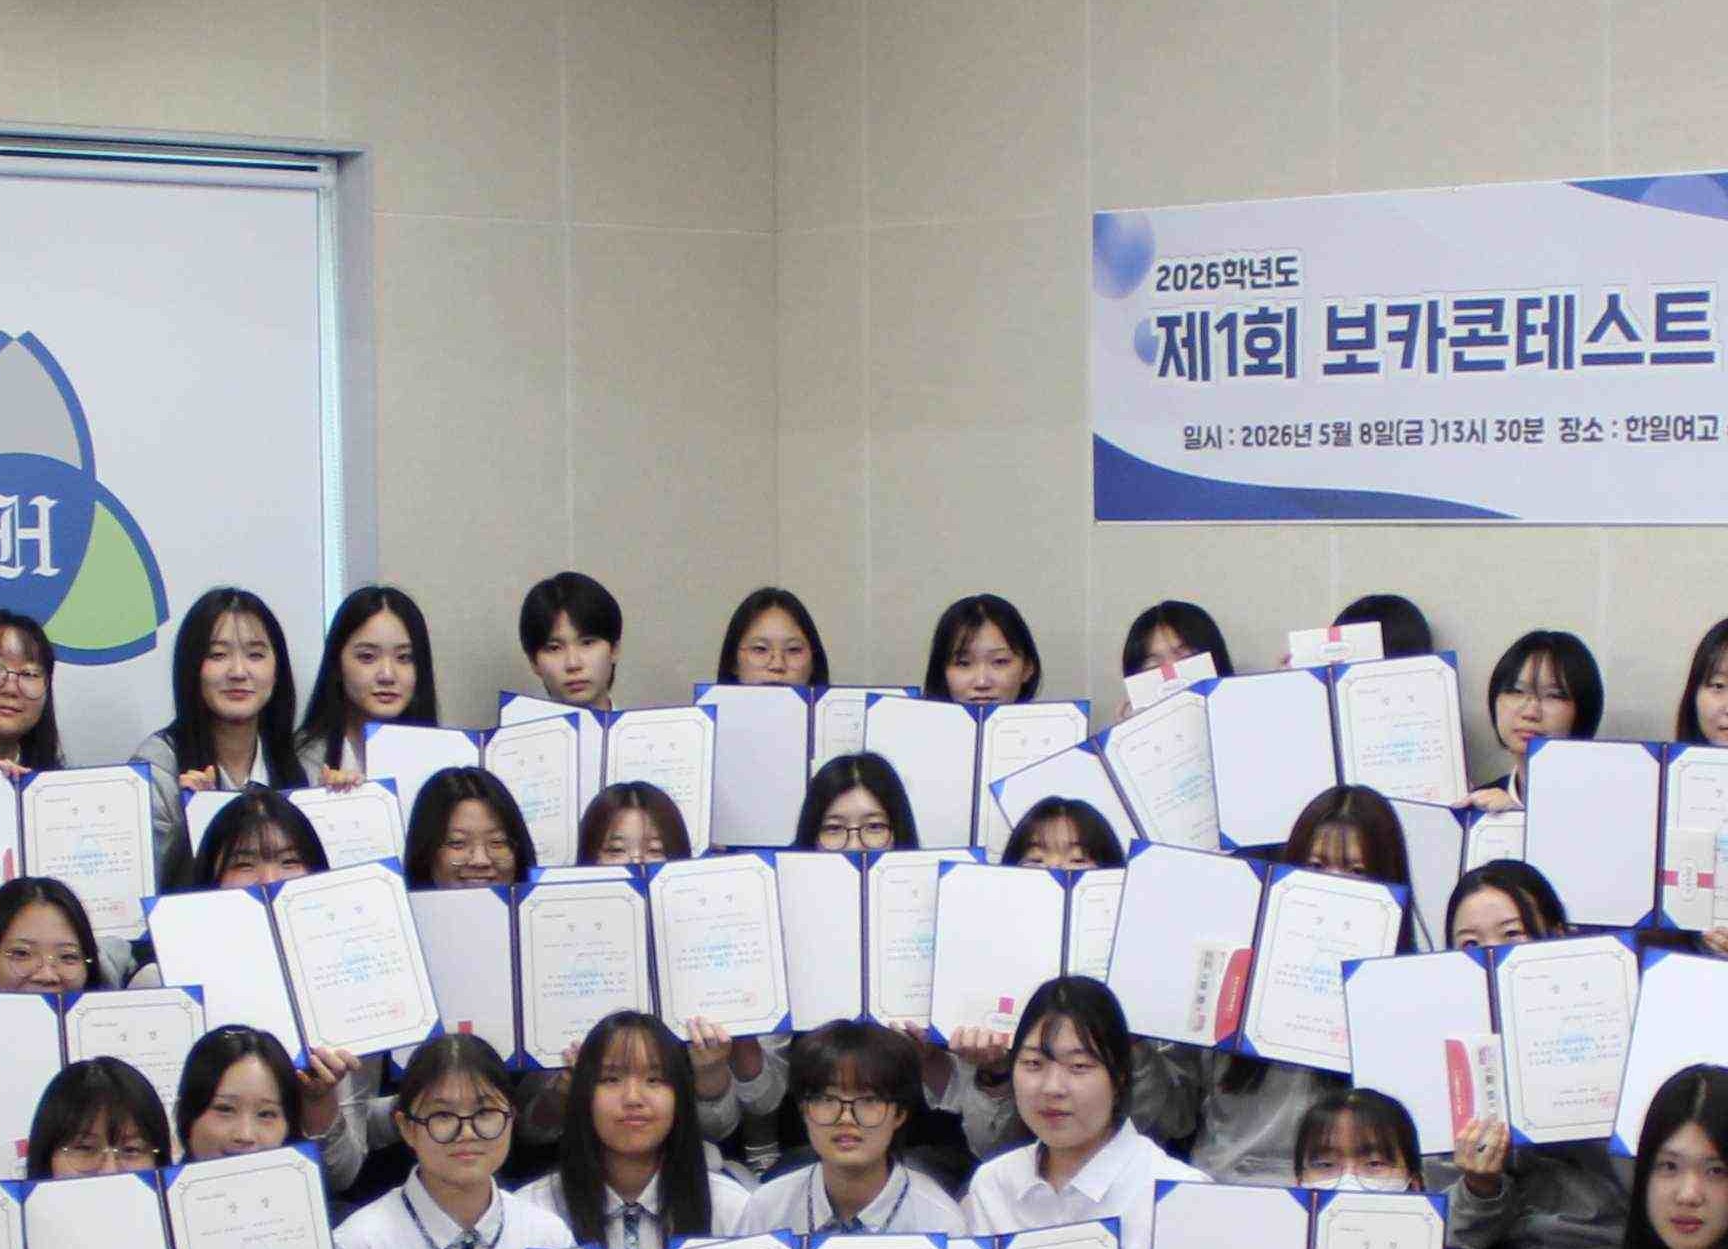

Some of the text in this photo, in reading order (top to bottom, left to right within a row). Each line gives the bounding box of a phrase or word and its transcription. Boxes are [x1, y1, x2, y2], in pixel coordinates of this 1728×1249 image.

[1156, 255, 1300, 292] 2026학년도
[1156, 305, 1298, 382] 제1회
[1322, 290, 1716, 376] 보카콘테스트
[1183, 423, 1222, 450] 일시
[1241, 421, 1313, 448] 2026년
[1318, 420, 1353, 448] 5월
[1494, 416, 1545, 445] 30분
[1559, 415, 1604, 444] 장소
[1625, 414, 1719, 443] 한일여고
